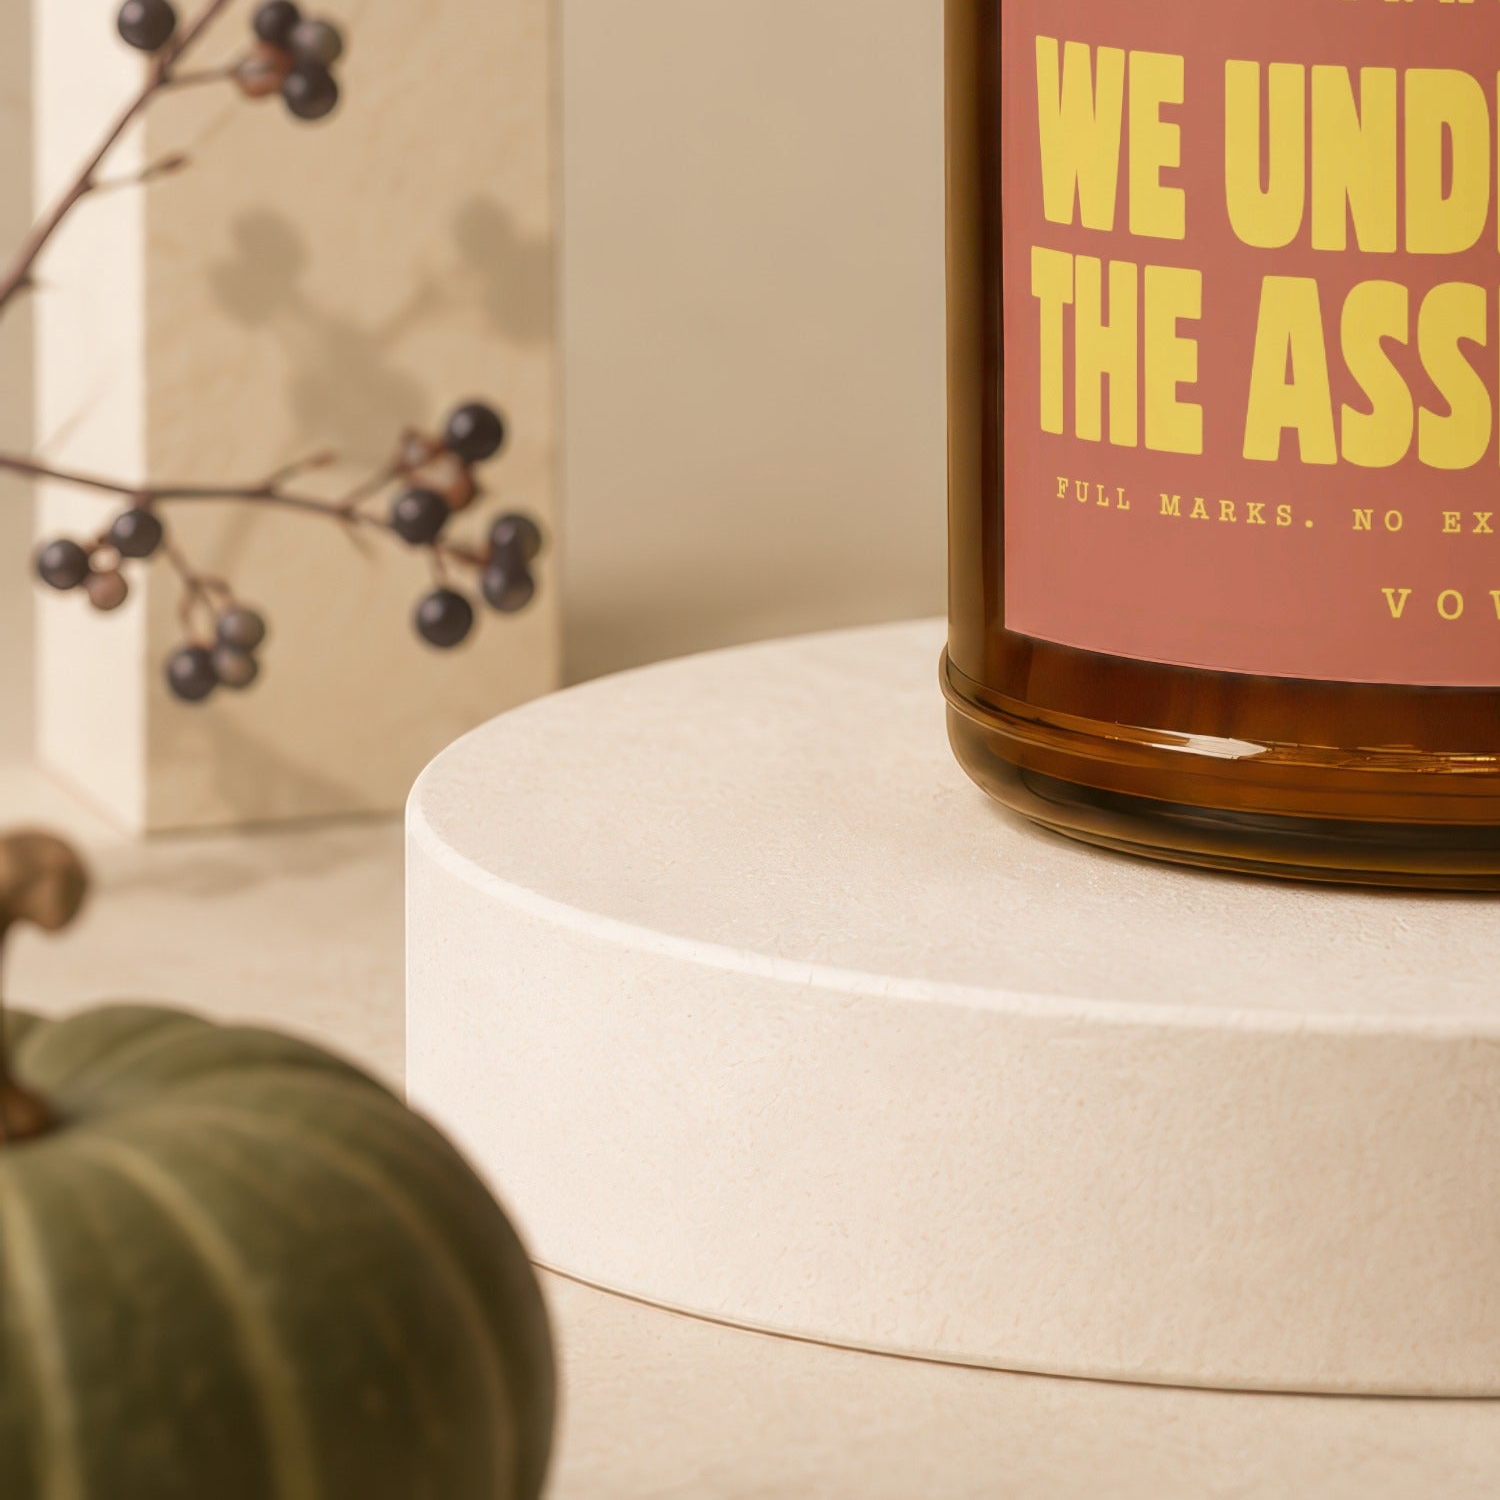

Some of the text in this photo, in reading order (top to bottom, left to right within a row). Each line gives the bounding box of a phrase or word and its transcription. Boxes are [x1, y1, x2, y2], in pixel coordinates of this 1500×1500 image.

[1034, 34, 1187, 241] WE
[1030, 244, 1204, 456] THE
[1055, 475, 1132, 511] FULL
[1159, 492, 1315, 529] MARKS.
[1352, 508, 1405, 533] NO
